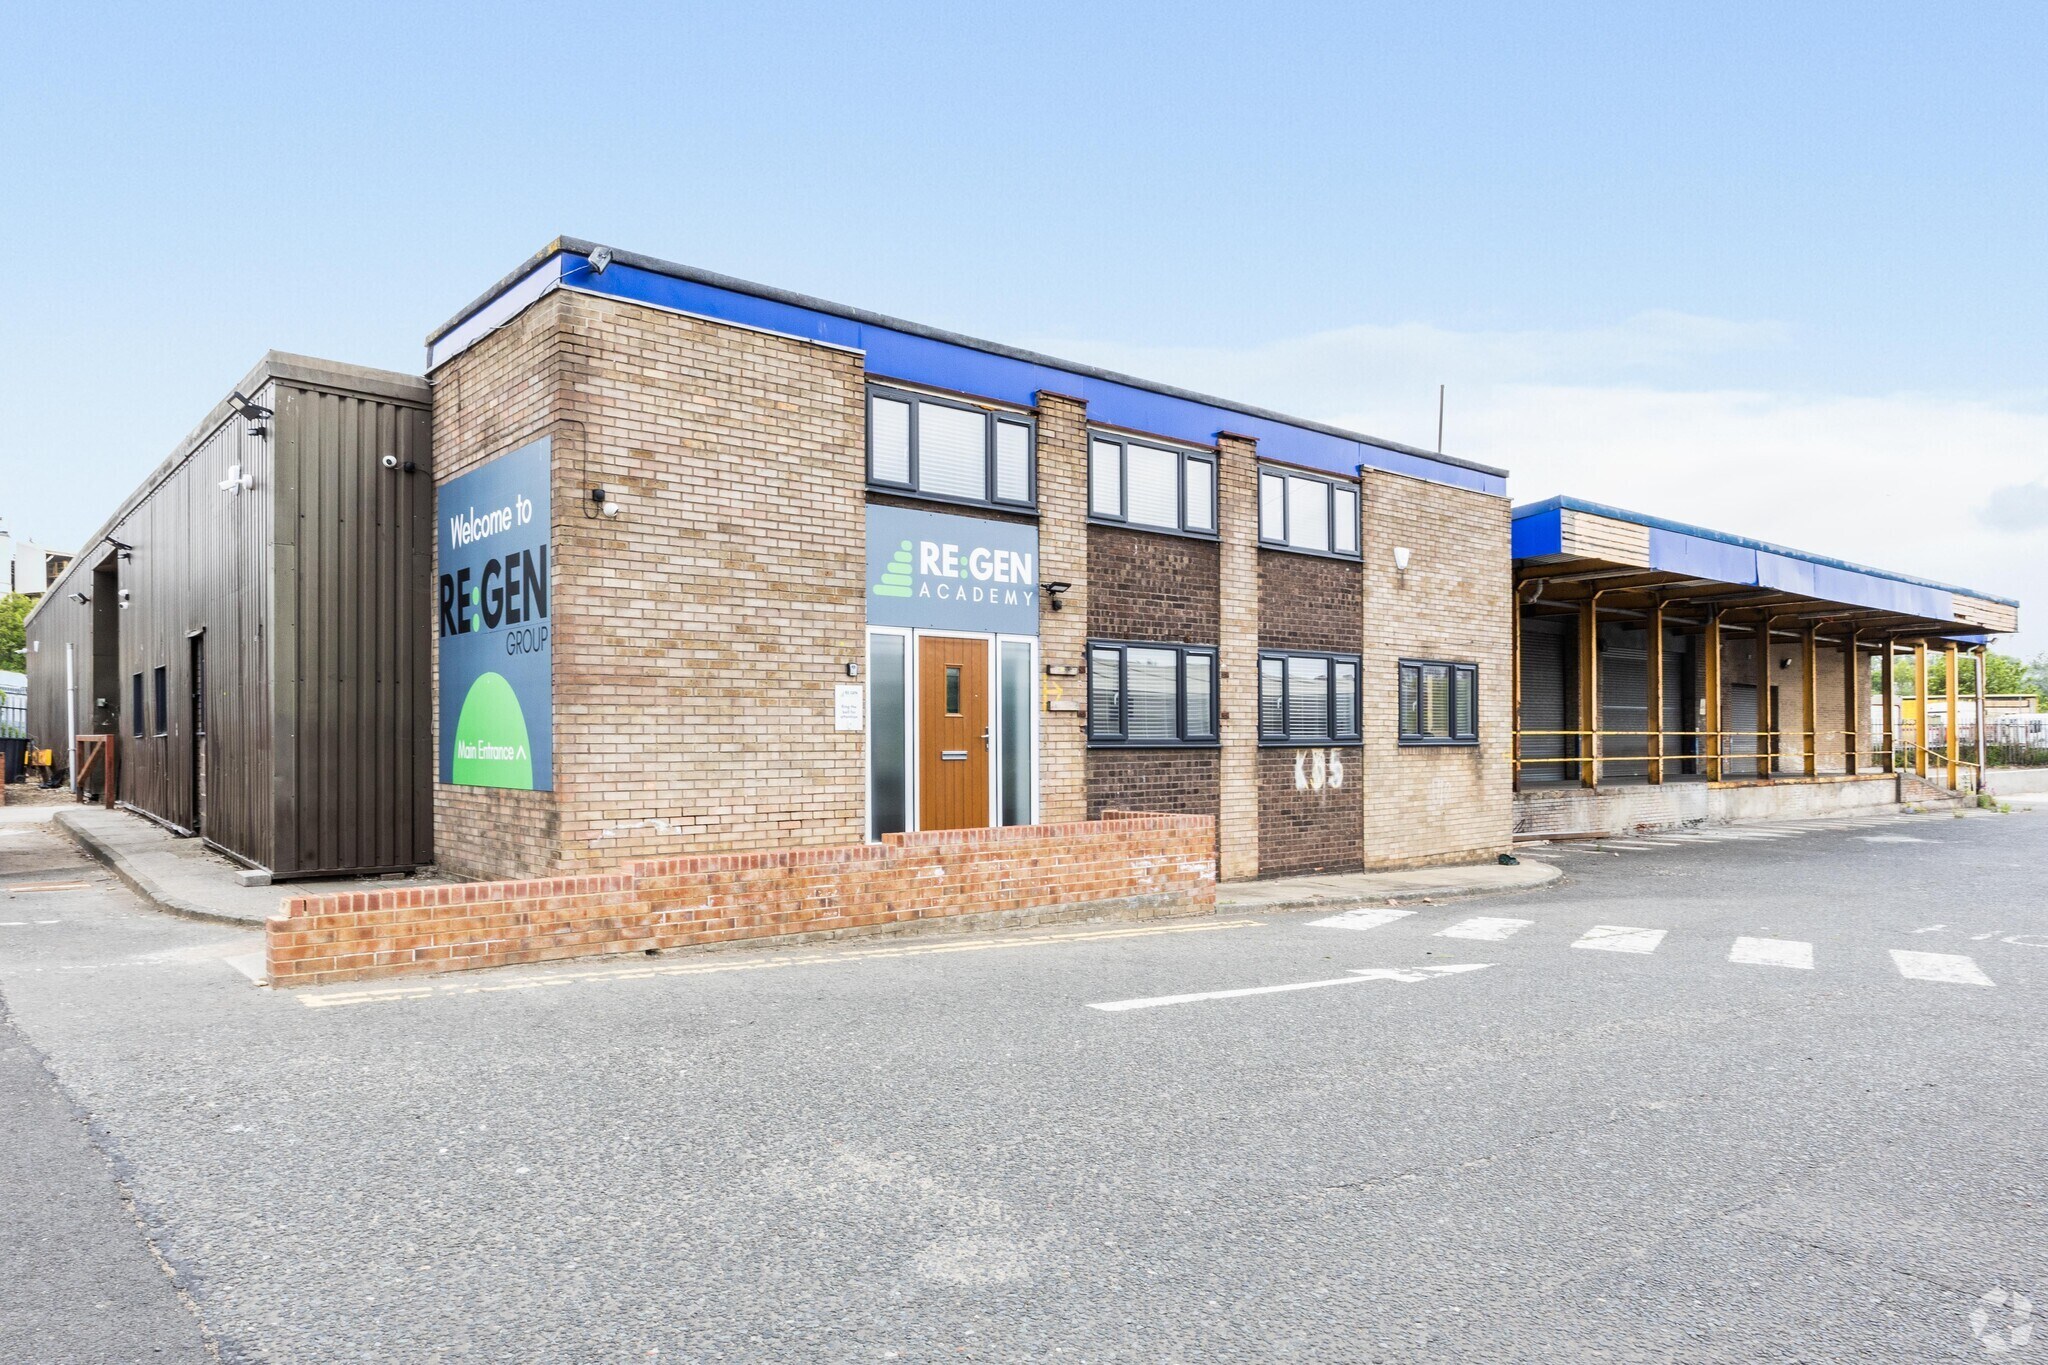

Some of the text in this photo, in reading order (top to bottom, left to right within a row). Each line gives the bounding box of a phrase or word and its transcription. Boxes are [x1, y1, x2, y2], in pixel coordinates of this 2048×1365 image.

[450, 494, 533, 550] Welcome to
[920, 540, 1032, 586] RE:GEN
[440, 544, 548, 638] RE:GEN
[919, 581, 1034, 607] ACADEMY
[506, 625, 549, 656] GROUP
[458, 740, 515, 760] Main Entrance
